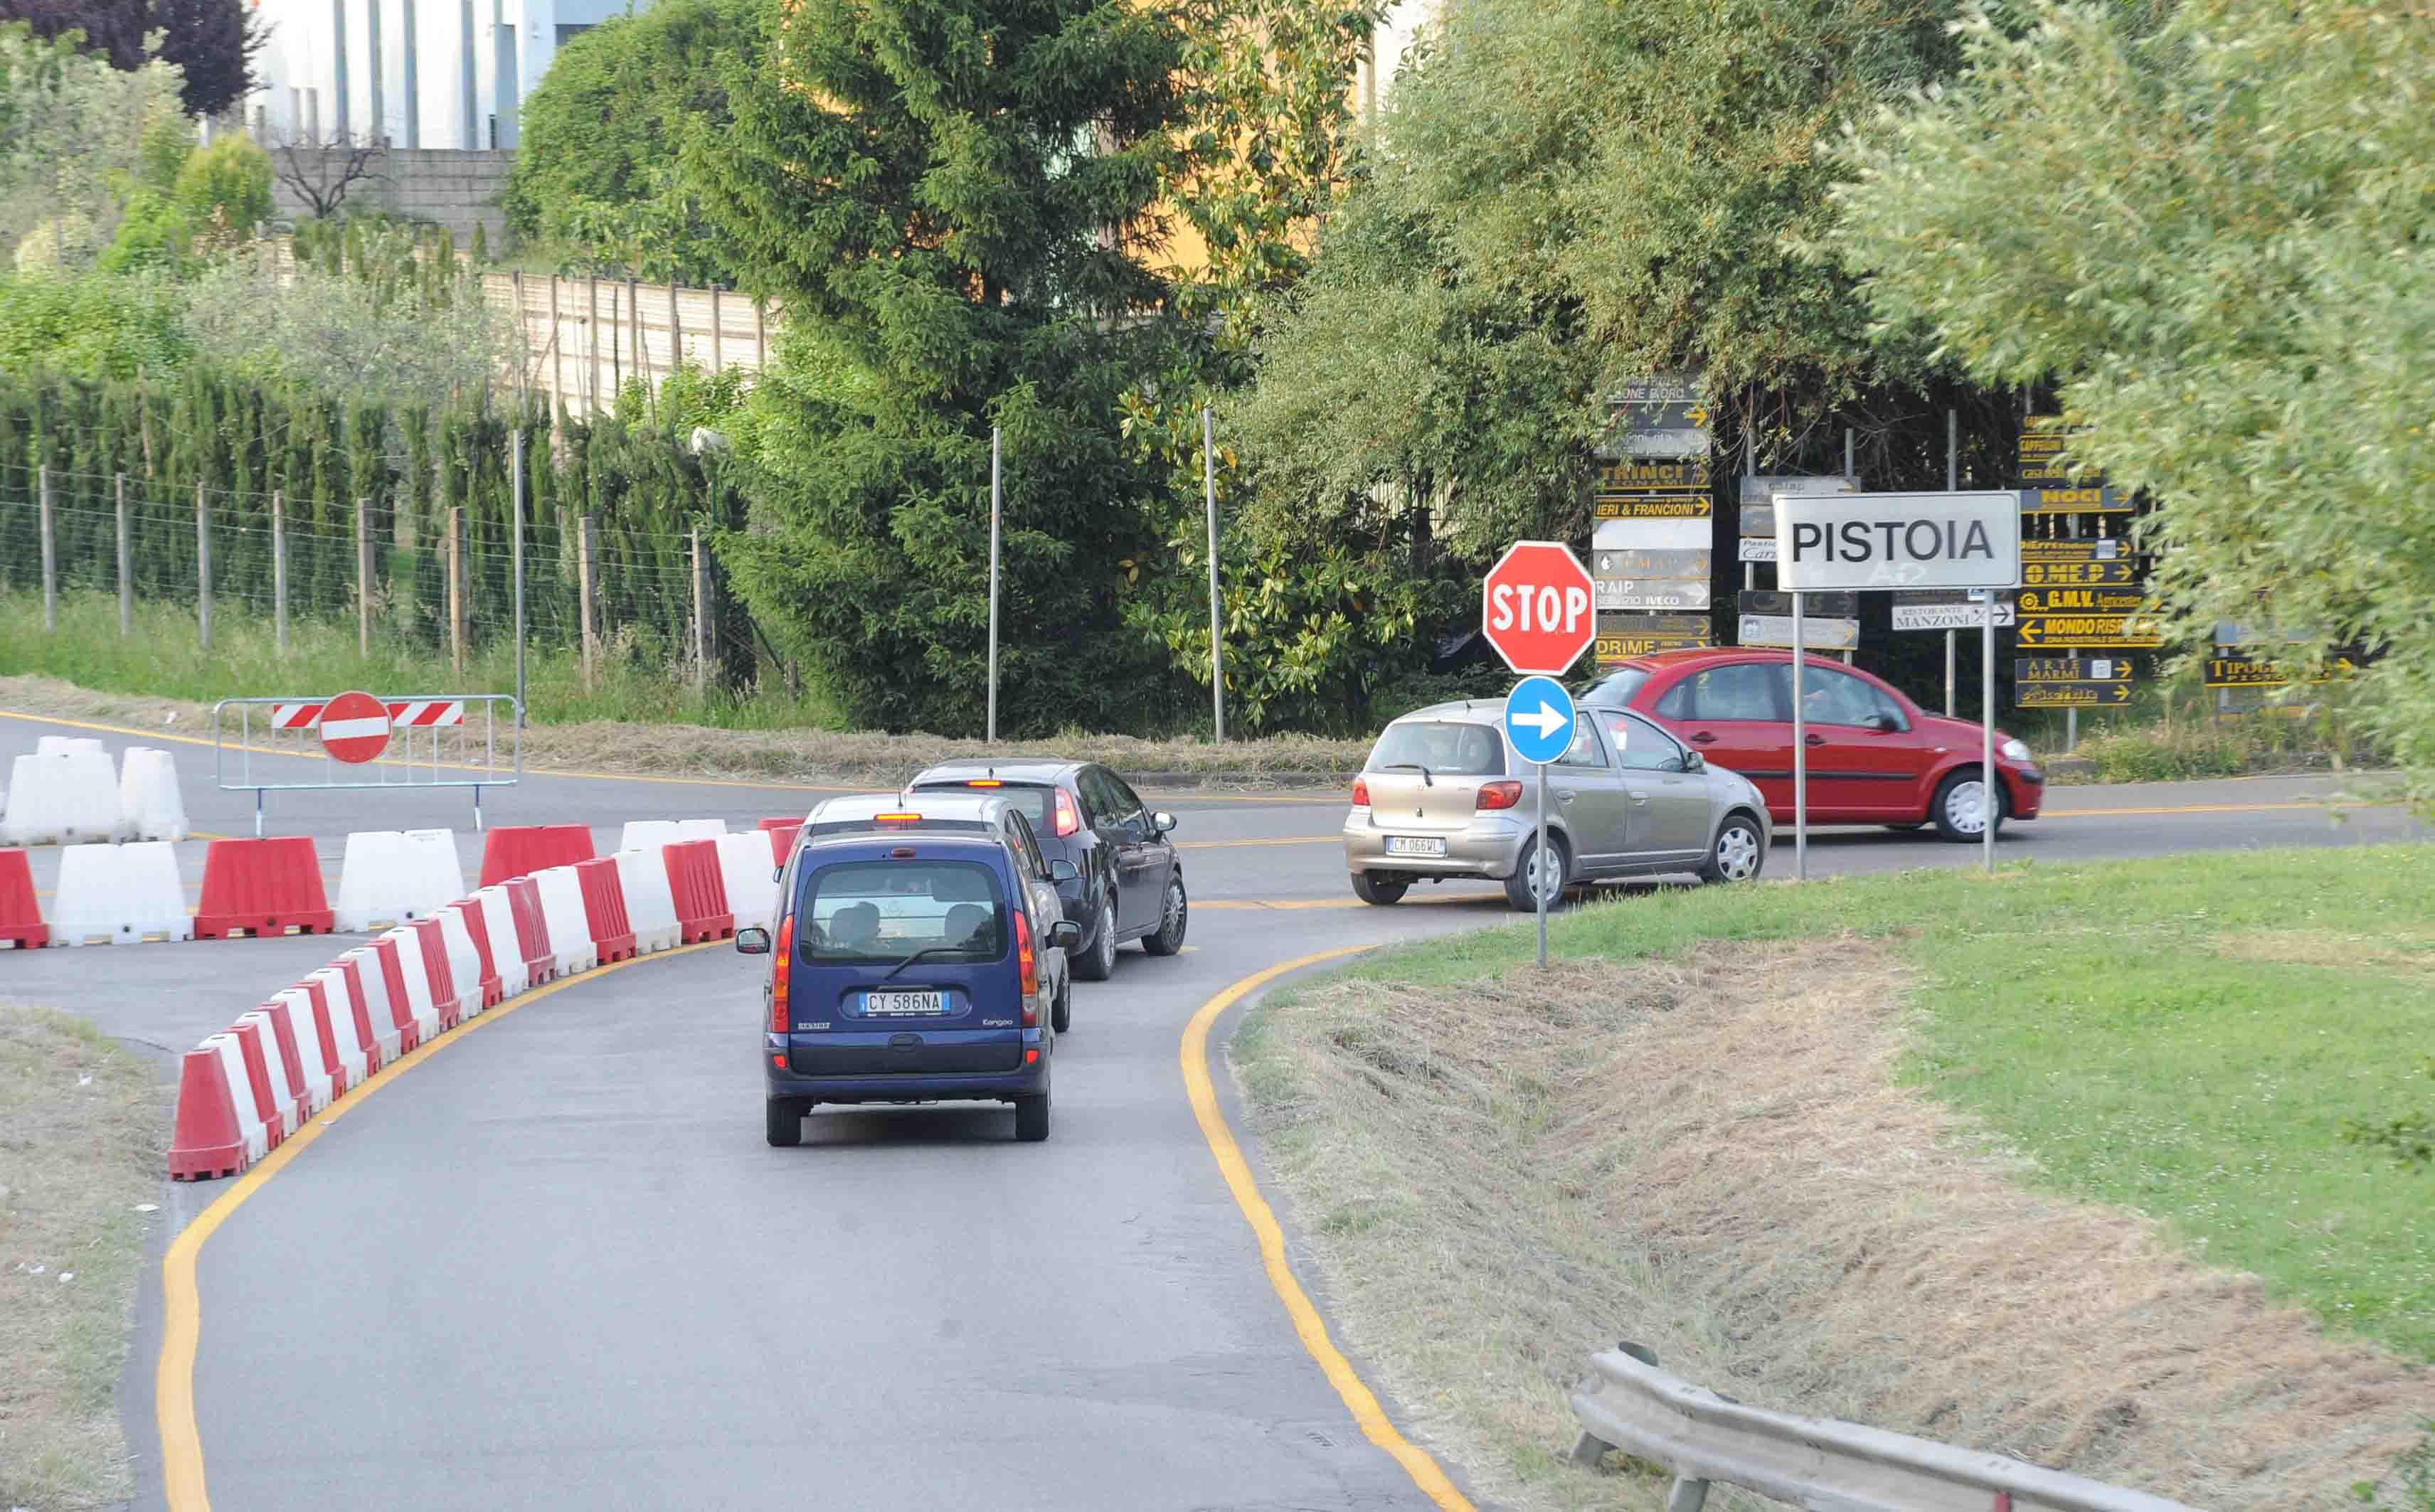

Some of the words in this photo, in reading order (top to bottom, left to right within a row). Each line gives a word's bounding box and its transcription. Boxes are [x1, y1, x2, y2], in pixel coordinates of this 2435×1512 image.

[1601, 467, 1684, 479] TRINCI
[1621, 504, 1631, 516] &
[1633, 503, 1694, 516] FRANCIONI
[1793, 520, 1994, 563] PISTOIA
[1596, 580, 1634, 593] RAIP
[1492, 583, 1588, 633] STOP
[1896, 614, 1969, 627] MANZONI
[869, 994, 886, 1010] CY
[893, 994, 940, 1009] 586NA
